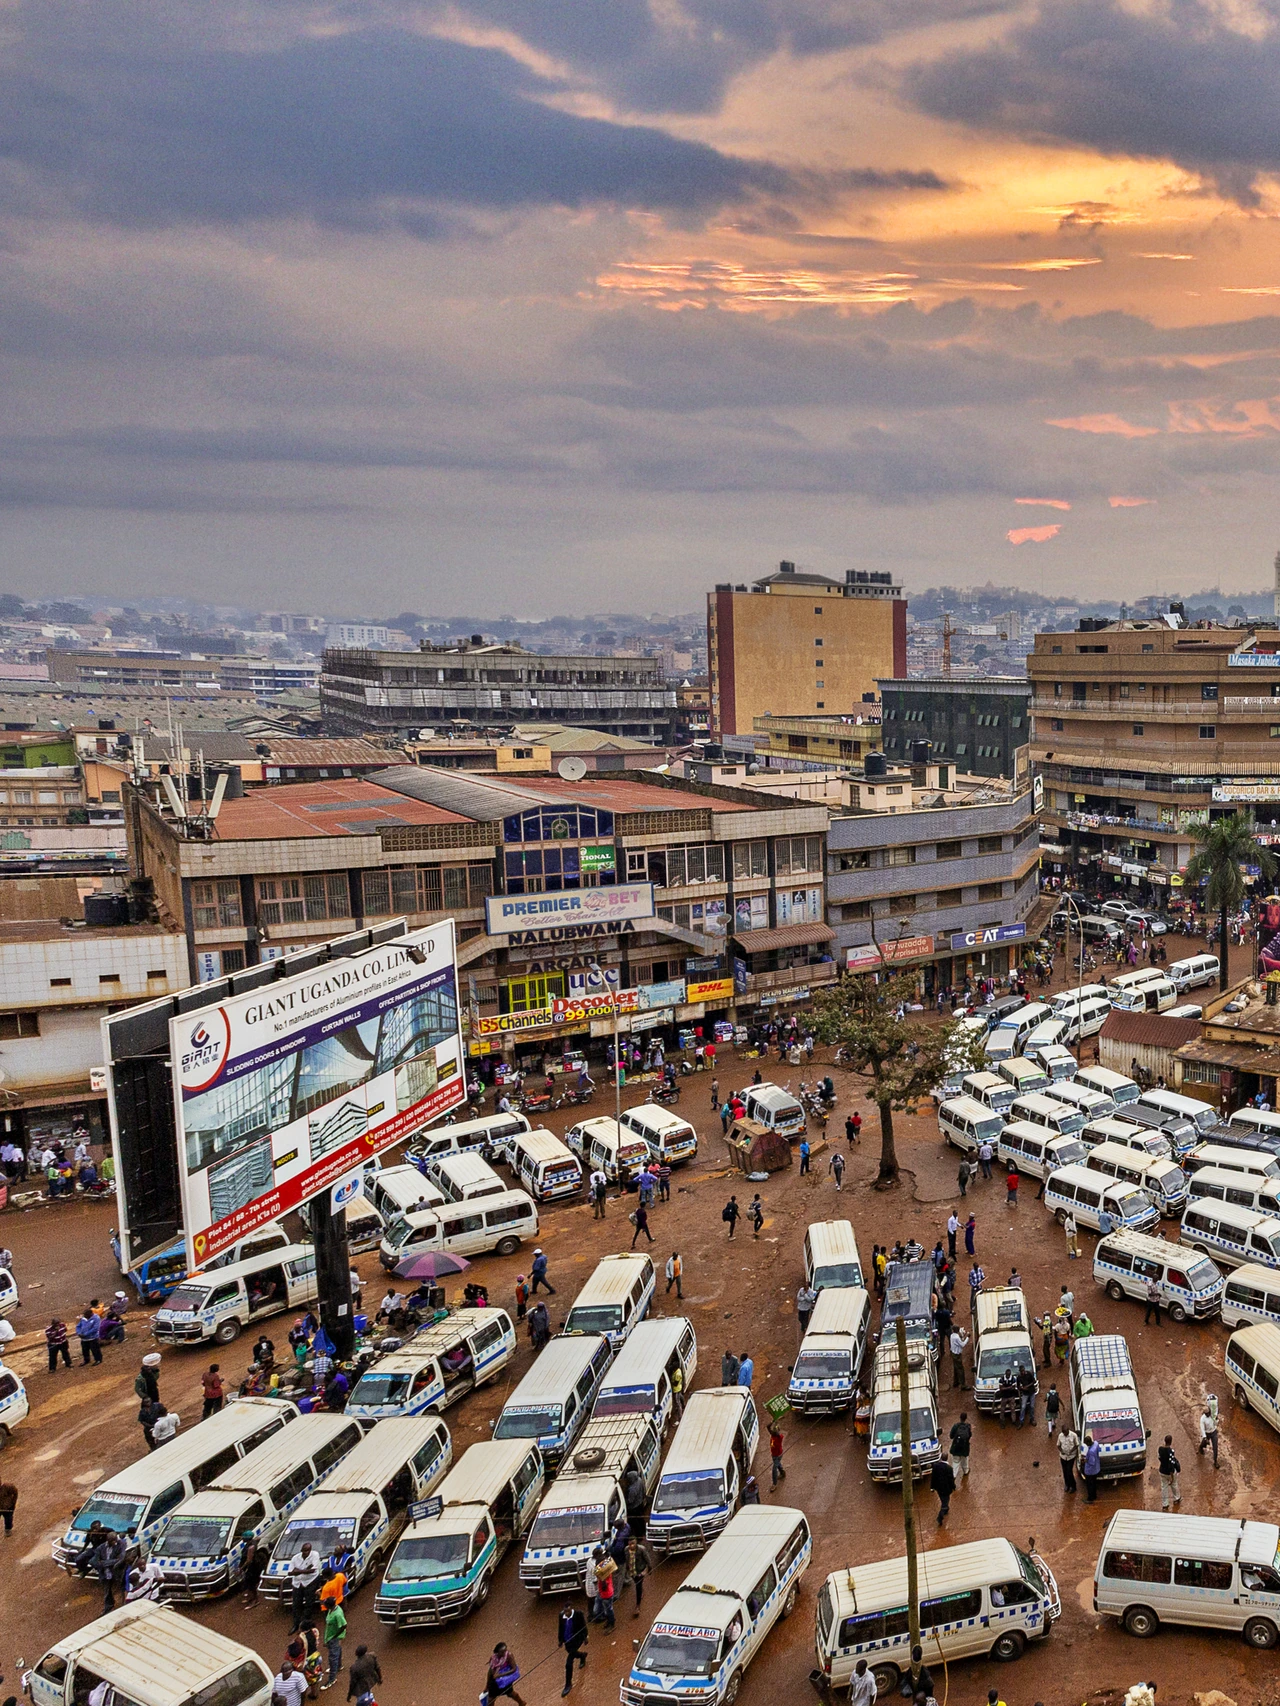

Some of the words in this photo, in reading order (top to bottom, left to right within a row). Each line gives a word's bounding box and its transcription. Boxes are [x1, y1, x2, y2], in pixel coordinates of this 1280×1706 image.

[1255, 654, 1279, 667] Jubilee
[1223, 785, 1255, 795] COCORICO
[1256, 785, 1270, 795] BAR
[1270, 786, 1276, 795] &
[502, 896, 581, 917] PREMIER
[608, 890, 641, 905] BET
[508, 920, 635, 945] NALUBWAMA
[965, 928, 1000, 946] CEAT
[918, 945, 929, 953] Ltd
[528, 953, 608, 974] ARCADE
[245, 991, 297, 1025] GIANT
[300, 968, 360, 1004] UGANDA
[362, 960, 385, 979] CO.
[378, 996, 395, 1009] OFFICE
[394, 987, 416, 1002] PARTITION
[420, 980, 431, 991] SHOP
[430, 973, 447, 986] FRONTS
[697, 982, 725, 993] DHL
[273, 1020, 288, 1033] No.1
[288, 1004, 330, 1027] manufacturers
[329, 1000, 337, 1009] of
[336, 989, 364, 1006] Aluminium
[363, 981, 382, 997] profiles
[382, 978, 387, 987] in
[387, 974, 398, 985] East
[398, 969, 412, 980] Africa
[552, 990, 638, 1013] Decoder
[321, 1018, 344, 1033] CURTAIN
[344, 1010, 362, 1024] WALLS
[500, 1010, 552, 1031] Channels
[254, 1051, 275, 1065] DOORS
[280, 1035, 307, 1053] WINDOWS
[276, 1152, 295, 1167] INGOTS
[300, 1147, 359, 1188] www.giantuganda.co.ug
[301, 1153, 363, 1197] giant.uganda@gmail.com
[208, 1227, 223, 1239] Plot
[249, 1204, 261, 1215] 7th
[261, 1191, 280, 1208] street
[209, 1228, 241, 1252] industrial
[241, 1217, 257, 1231] area
[270, 1202, 281, 1215] (U)
